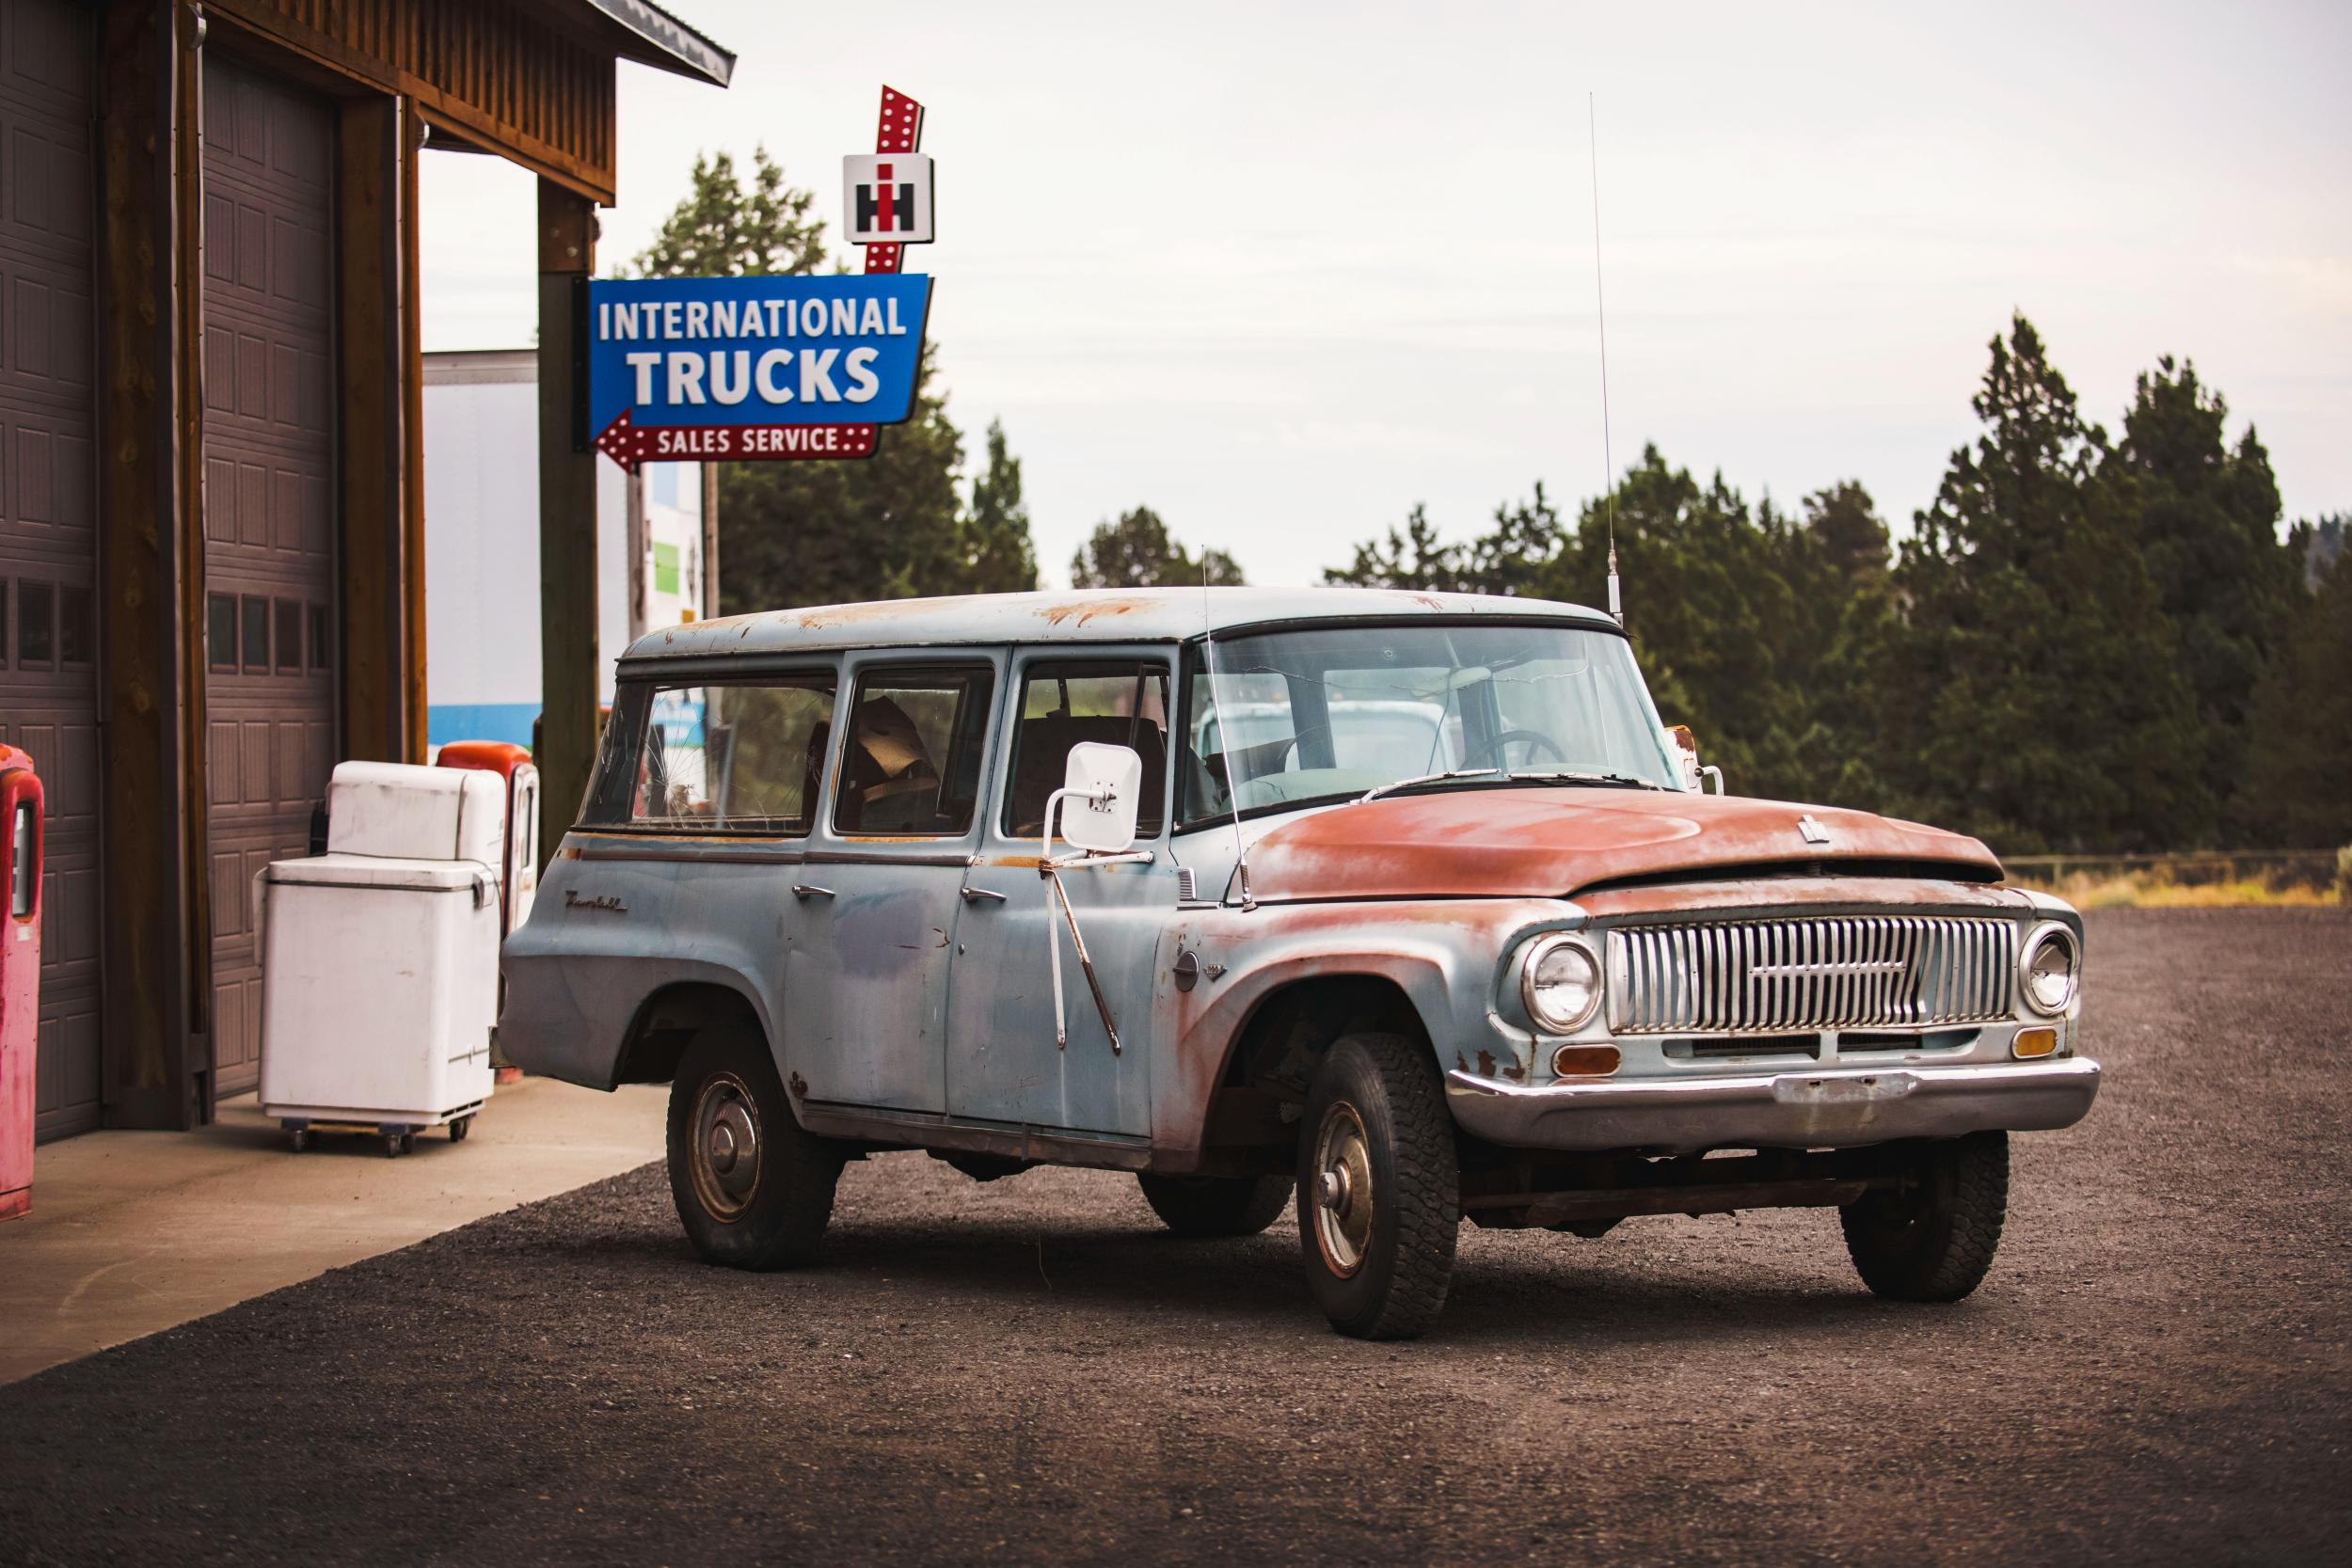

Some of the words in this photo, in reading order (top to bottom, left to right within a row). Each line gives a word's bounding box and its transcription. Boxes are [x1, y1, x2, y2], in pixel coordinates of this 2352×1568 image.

[599, 297, 906, 340] INTERNATIONAL
[627, 346, 880, 404] TRUCKS
[658, 430, 730, 453] SALES
[742, 427, 838, 451] SERVICE
